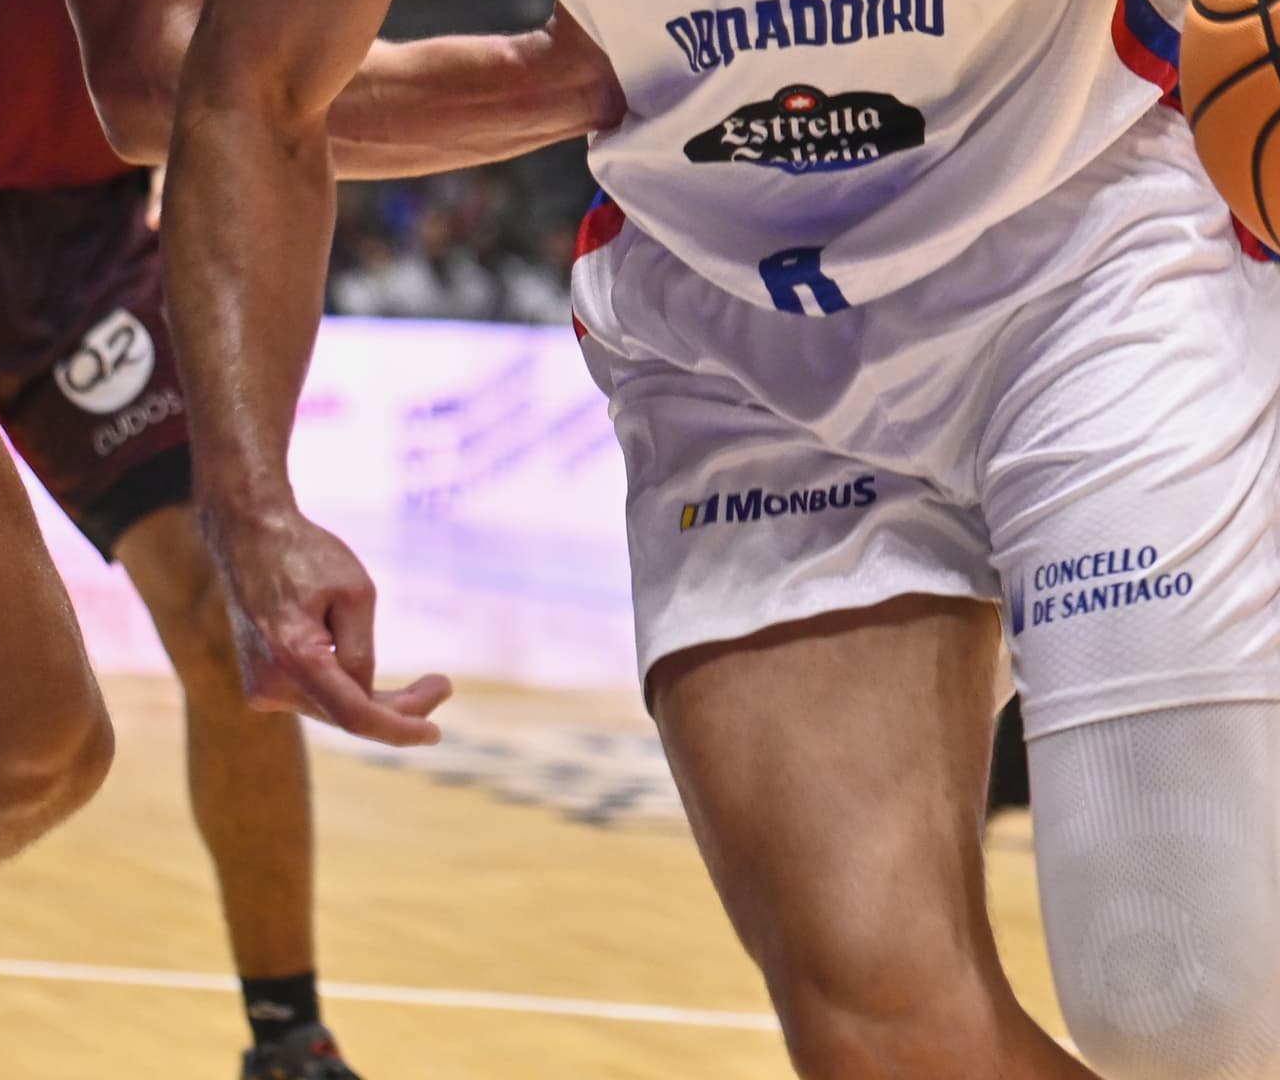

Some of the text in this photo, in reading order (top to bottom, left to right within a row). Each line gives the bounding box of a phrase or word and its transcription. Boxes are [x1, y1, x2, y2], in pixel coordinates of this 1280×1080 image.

[720, 107, 883, 145] Estrella
[1033, 544, 1159, 591] CONCELLO
[1032, 571, 1194, 627] DE SANTIAGO
